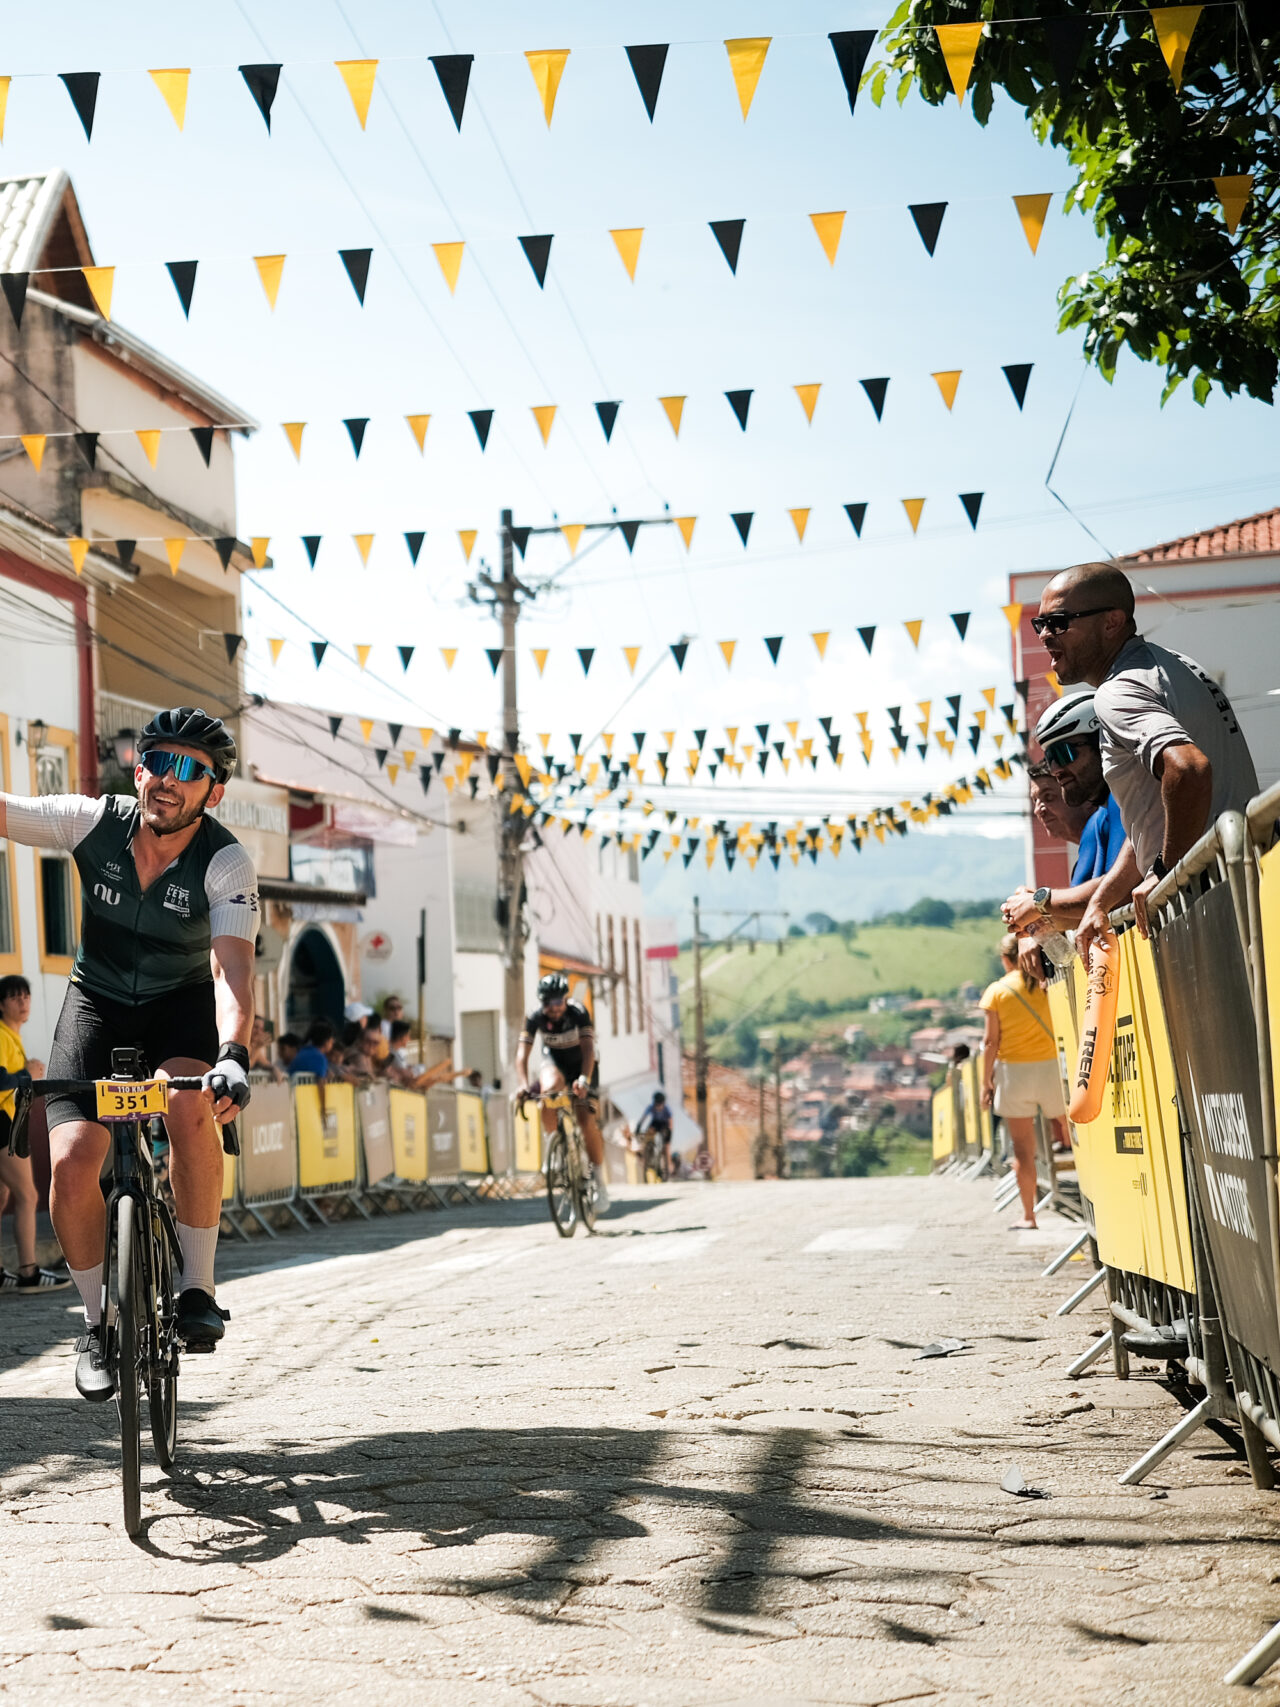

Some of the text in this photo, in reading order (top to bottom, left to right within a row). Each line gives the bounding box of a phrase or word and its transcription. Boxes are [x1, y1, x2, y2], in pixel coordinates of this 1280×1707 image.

[1077, 1026, 1098, 1091] TREK
[114, 1094, 148, 1110] 351
[117, 1085, 145, 1093] 110 KM
[1200, 1092, 1254, 1161] MITSUBISHI
